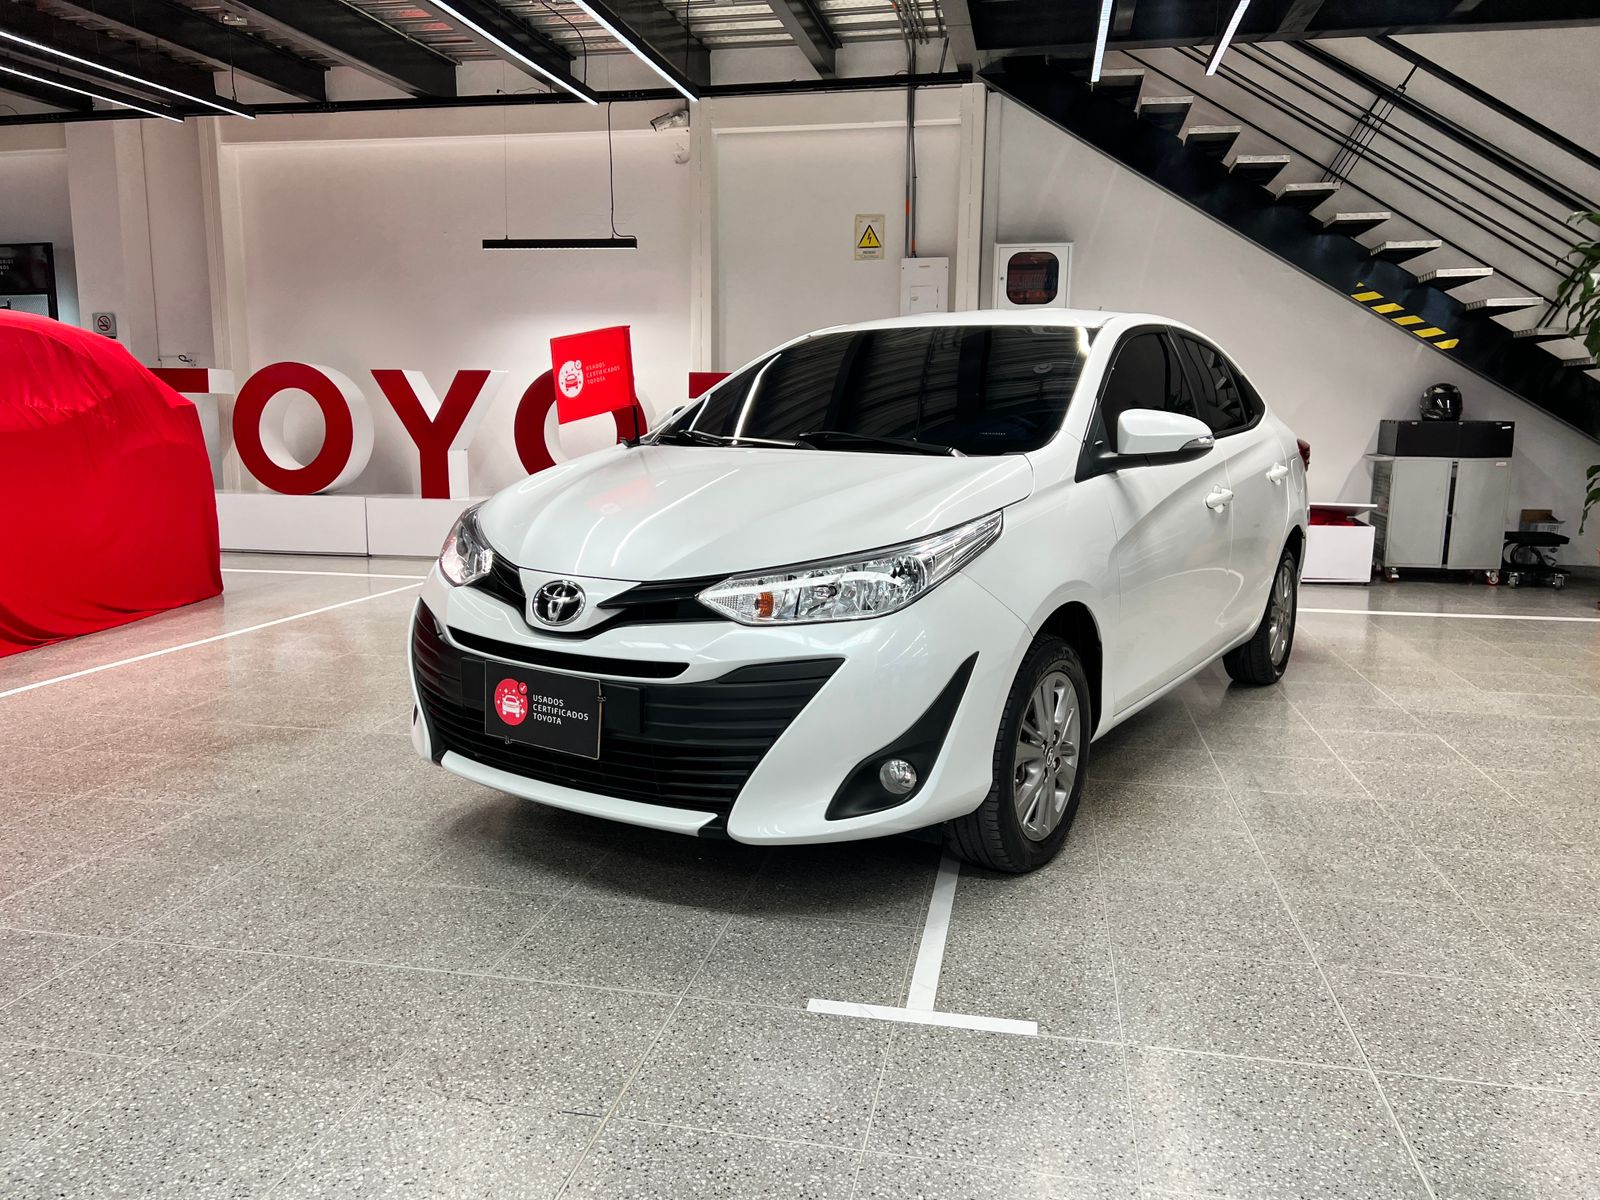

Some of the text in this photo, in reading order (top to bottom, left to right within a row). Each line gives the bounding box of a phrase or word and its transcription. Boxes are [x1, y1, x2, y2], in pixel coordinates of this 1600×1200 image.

[532, 694, 564, 707] USADOS
[532, 703, 589, 721] CERTIFICADOS
[532, 712, 562, 725] TOYOTA
